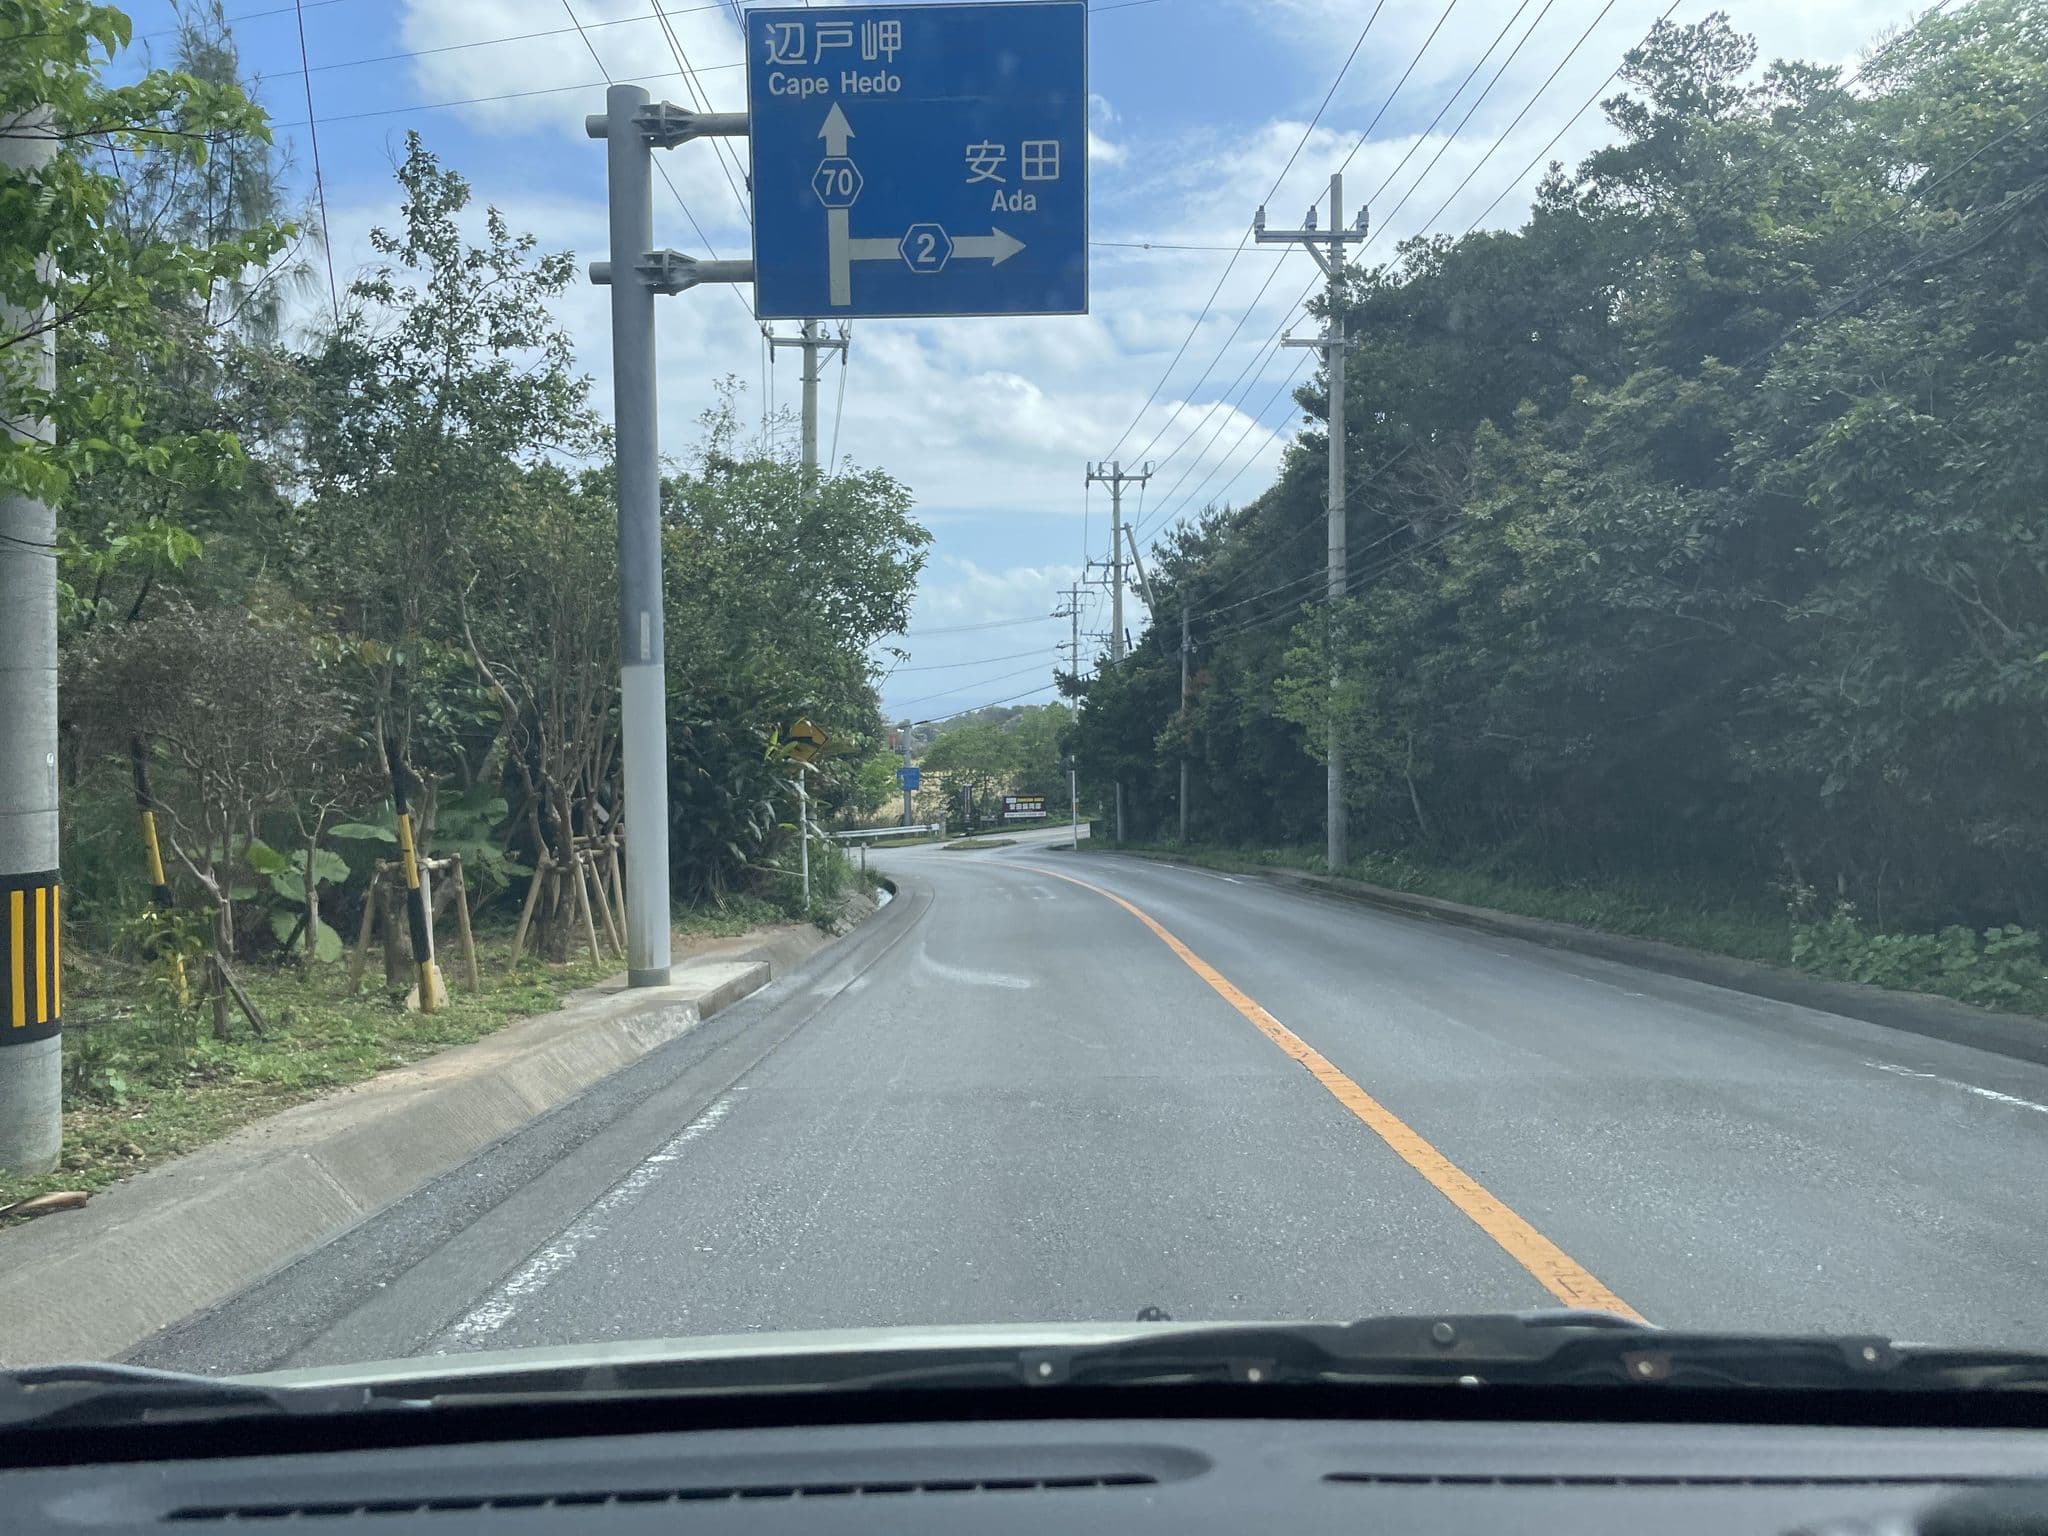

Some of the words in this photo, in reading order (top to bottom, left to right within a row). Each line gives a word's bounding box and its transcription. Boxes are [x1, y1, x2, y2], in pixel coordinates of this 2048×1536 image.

[765, 19, 901, 65] 辺戸岬
[769, 72, 829, 99] Cape
[841, 70, 901, 94] Hedo
[965, 139, 1060, 183] 安田
[822, 168, 853, 196] 70
[991, 189, 1037, 212] Ada
[917, 233, 936, 263] 2
